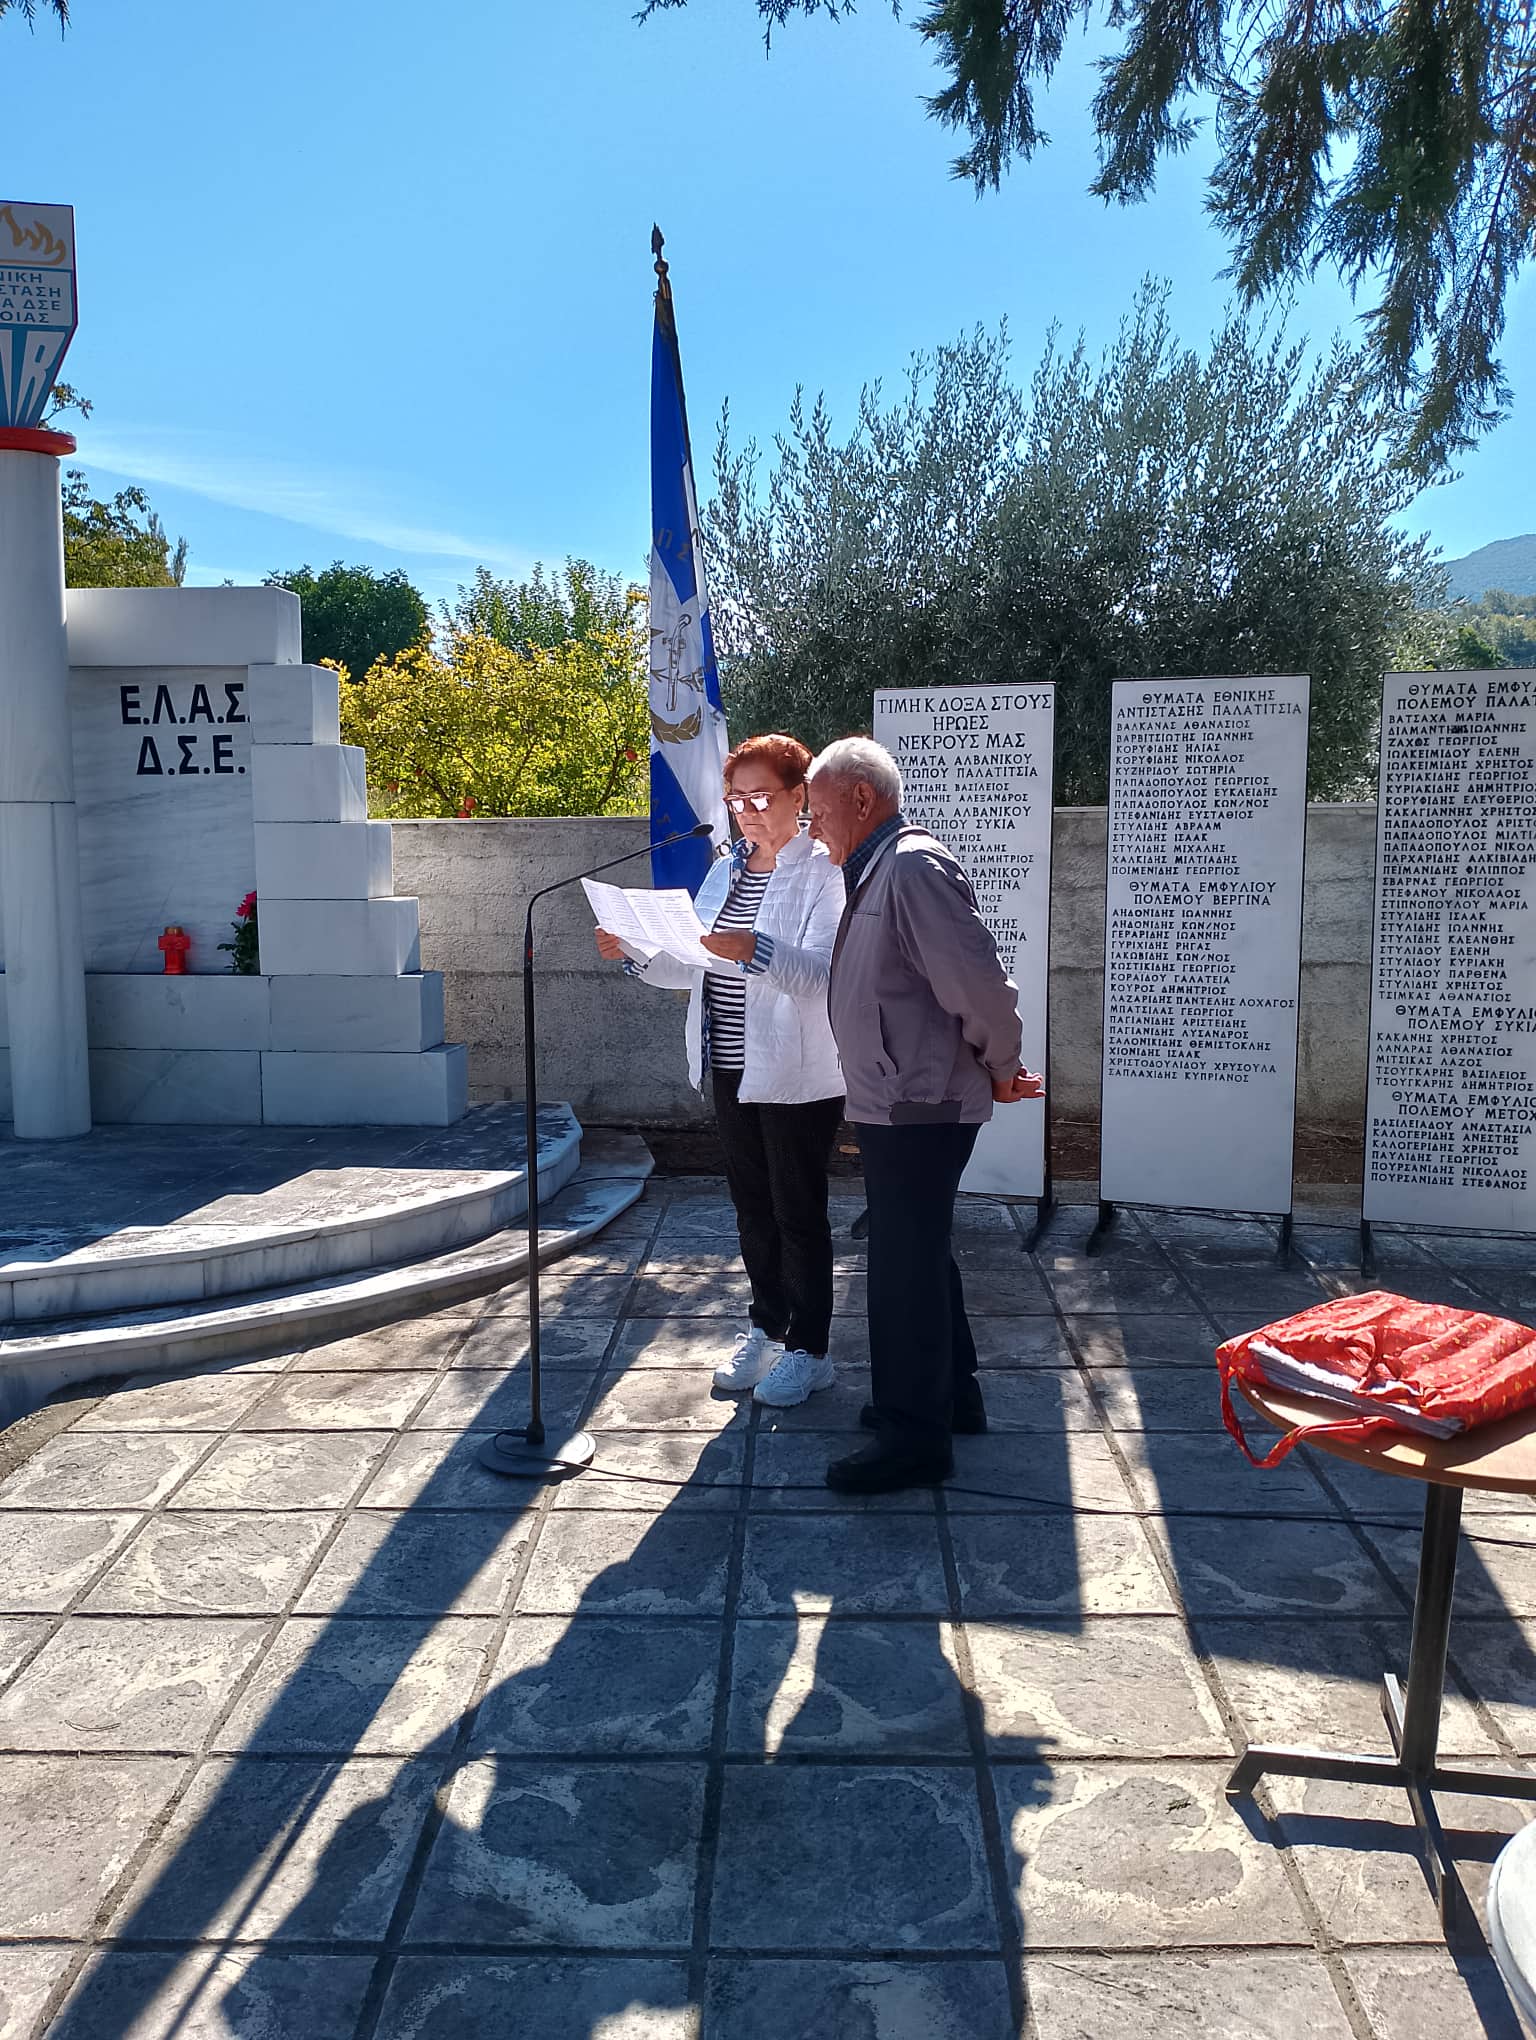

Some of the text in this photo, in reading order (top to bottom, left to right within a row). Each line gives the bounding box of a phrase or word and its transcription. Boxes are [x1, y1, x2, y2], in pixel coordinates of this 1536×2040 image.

[23, 299, 61, 311] ΔΣΕ
[1409, 683, 1478, 696] ΘΥΜΑΤΑ
[1142, 690, 1275, 704] ΘΥΜΑΤΑ ΕΘΝΙΚΗΣ
[876, 698, 921, 714] ΤΙΜΗ
[938, 696, 987, 713] ΔΟΞΑ
[991, 693, 1052, 711] ΣΤΟΥΣ
[1397, 696, 1476, 710] ΠΟΛΕΜΟΥ
[1117, 703, 1302, 719] ΑΝΤΙΣΤΑΣΗΣ ΠΑΛΑΤΙΤΣΙΑ
[932, 714, 989, 731] ΗΡΩΕΣ
[1389, 712, 1495, 724] ΒΑΤΣΑΧΑ ΜΑΡΙΑ
[1183, 720, 1250, 730] ΑΘΑΝΑΣΙΟΣ
[1470, 723, 1527, 734] ΙΩΑΝΝΗΣ
[897, 733, 1026, 751] ΝΕΚΡΟΥΣ ΜΑΣ
[1202, 732, 1254, 742] ΙΩΑΝΝΗΣ
[1438, 735, 1498, 746] ΓΕΩΡΓΙΟΣ
[1116, 743, 1220, 754] ΚΟΡΥΦΙΔΗΣ ΗΛΙΑΣ
[1387, 747, 1520, 759] ΙΩΑΚΕΙΜΙΔΟΥ ΕΛΕΝΗ
[136, 734, 246, 776] Δ.Σ.Ε.
[954, 753, 1032, 766] ΑΛΒΑΝΙΚΟΥ
[1116, 754, 1245, 765] ΚΟΡΥΦΙΔΗΣ ΝΙΚΟΛΑΟΣ
[1115, 765, 1236, 776] ΚΥΖΗΡΙΔΟΥ ΣΩΤΗΡΙΑ
[1387, 759, 1534, 771] ΙΩΑΚΕΙΜΙΔΗΣ ΧΡΗΣΤΟΣ
[957, 765, 1038, 779] ΠΑΛΑΤΙΤΣΙΑ
[1386, 771, 1529, 783] ΚΥΡΙΑΚΙΔΗΣ ΓΕΩΡΓΙΟΣ
[954, 782, 1010, 792] ΒΑΣΙΛΕΙΟΣ
[1115, 776, 1269, 787] ΠΑΠΑΔΟΠΟΥΛΟΣ ΓΕΩΡΓΙΟΣ
[1115, 787, 1278, 798] ΠΑΠΑΔΟΠΟΥΛΟΣ ΕΥΚΛΕΙΔΗΣ
[1386, 783, 1460, 794] ΚΥΡΙΑΚΙΔΗΣ
[958, 793, 1028, 803] ΑΛΕΞΑΝΔΡΟΣ
[1385, 795, 1455, 806] ΚΟΡΥΦΙΔΗΣ
[1114, 799, 1207, 809] ΠΑΠΑΔΟΠΟΥΛΟΣ
[953, 806, 1031, 818] ΑΛΒΑΝΙΚΟΥ
[1114, 810, 1254, 821] ΣΤΕΦΑΝΙΔΗΣ ΕΥΣΤΑΘΙΟΣ
[1385, 807, 1473, 817] ΚΑΚΑΓΙΑΝΝΗΣ
[976, 818, 1016, 830] ΣΥΚΙΑ
[1113, 821, 1221, 831] ΣΤΥΛΙΔΗΣ ΑΒΡΑΑΜ
[1384, 818, 1488, 829] ΠΑΠΑΔΟΠΟΥΛΟΣ
[1113, 832, 1208, 842] ΣΤΥΛΙΔΗΣ ΙΣΑΑΚ
[1384, 830, 1487, 841] ΠΑΠΑΔΟΠΟΥΛΟΣ
[958, 844, 1007, 853] ΜΙΧΑΛΗΣ
[1112, 844, 1226, 854] ΣΤΥΛΙΔΗΣ ΜΙΧΑΛΗΣ
[1384, 842, 1487, 852] ΠΑΠΑΔΟΠΟΥΛΟΣ
[973, 854, 1034, 865] ΔΗΜΗΤΡΙΟΣ
[1112, 855, 1237, 865] ΧΑΛΚΙΔΗΣ ΜΙΛΤΙΑΔΗΣ
[1383, 854, 1460, 864] ΠΑΡΧΑΡΙΔΗΣ
[1112, 866, 1240, 876] ΠΟΙΜΕΝΙΔΗΣ ΓΕΩΡΓΙΟΣ
[1465, 865, 1526, 875] ΦΙΛΙΠΠΟΣ
[972, 880, 1021, 891] ΕΡΓΙΝΑ
[1129, 881, 1276, 893] ΘΥΜΑΤΑ ΕΜΦΥΛΙΟΥ
[1382, 877, 1504, 887] ΣΒΑΡΝΑΣ ΓΕΩΡΓΙΟΣ
[1382, 888, 1521, 899] ΣΤΕΦΑΝΟΥ ΝΙΚΟΛΑΟΣ
[1134, 894, 1271, 906] ΠΟΛΕΜΟΥ ΒΕΡΓΙΝΑ
[1489, 900, 1528, 910] ΜΑΡΙΑ
[1112, 908, 1232, 919] ΑΗΔΟΝΙΔΗΣ ΙΩΑΝΝΗΣ
[1381, 911, 1486, 921] ΣΤΥΛΙΔΗΣ ΙΣΑΑΚ
[1112, 919, 1175, 930] ΑΗΔΟΝΙΔΗΣ
[1380, 923, 1504, 933] ΣΤΥΛΙΔΗΣ ΙΩΑΝΝΗΣ
[1112, 930, 1227, 940] ΓΕΡΑΡΙΔΗΣ ΙΩΑΝΝΗΣ
[1380, 934, 1515, 945] ΣΤΥΛΙΔΗΣ ΚΛΕΑΝΘΗΣ
[1175, 942, 1211, 951] ΡΗΓΑΣ
[1380, 945, 1490, 956] ΣΤΥΛΙΔΟΥ ΕΛΕΝΗ
[1110, 961, 1236, 973] ΚΩΣΤΙΚΙΔΗΣ ΓΕΩΡΓΙΟΣ
[1379, 957, 1504, 968] ΣΤΥΛΙΔΟΥ ΚΥΡΙΑΚΗ
[1174, 974, 1230, 985] ΓΑΛΑΤΕΙΑ
[1379, 968, 1507, 980] ΣΤΥΛΙΔΟΥ ΠΑΡΘΕΝΑ
[1110, 983, 1226, 995] ΚΟΥΡΟΣ ΔΗΜΗΤΡΙΟΣ
[1378, 979, 1503, 991] ΣΤΥΛΙΔΗΣ ΧΡΗΣΤΟΣ
[1110, 994, 1295, 1008] ΛΑΖΑΡΙΔΗΣ ΠΑΝΤΕΛΗΣ ΛΟΧΑΓΟΣ
[1439, 992, 1511, 1002] ΑΘΑΝΑΣΙΟΣ
[1180, 1007, 1234, 1017] ΓΕΩΡΓΙΟΣ
[1395, 1005, 1462, 1018] ΘΥΜΑΤΑ
[1109, 1015, 1246, 1029] ΠΑΓΙΑΝΙΔΗΣ ΑΡΙΣΤΕΙΔΗΣ
[1408, 1018, 1485, 1031] ΠΟΛΕΜΟΥ
[1109, 1026, 1249, 1039] ΠΑΓΙΑΝΙΔΗΣ ΛΥΣΑΝΔΡΟΣ
[1109, 1036, 1271, 1051] ΣΑΛΟΝΙΚΙΔΗΣ ΘΕΜΙΣΤΟΚΛΗΣ
[1377, 1032, 1497, 1045] ΚΑΚΑΝΗΣ ΧΡΗΣΤΟΣ
[1109, 1046, 1201, 1059] ΧΙΟΝΙΔΗΣ ΙΣΑΑΚ
[1440, 1046, 1513, 1057] ΑΘΑΝΑΣΙΟΣ
[1108, 1057, 1276, 1073] ΧΡΙΣΤΟΔΟΥΛΙΔΟΥ ΧΡΥΣΟΥΛΑ
[1376, 1055, 1482, 1067] ΜΙΤΣΙΚΑΣ ΛΑΖΟΣ
[1185, 1072, 1249, 1083] ΚΥΠΡΙΑΝΟΣ
[1376, 1066, 1527, 1080] ΤΣΟΥΓΚΑΡΗΣ ΒΑΣΙΛΕΙΟΣ
[1376, 1077, 1534, 1092] ΤΣΟΥΓΚΑΡΗΣ ΔΗΜΗΤΡΙΟΣ
[1392, 1091, 1458, 1105] ΘΥΜΑΤΑ
[1398, 1104, 1475, 1118] ΠΟΛΕΜΟΥ
[1373, 1118, 1532, 1135] ΒΑΣΙΛΕΙΑΔΟΥ ΑΝΑΣΤΑΣΙΑ
[1373, 1128, 1519, 1144] ΚΑΛΟΓΕΡΙΔΗΣ ΑΝΕΣΤΗΣ
[1372, 1139, 1519, 1156] ΚΑΛΟΓΕΡΙΔΗΣ ΧΡΗΣΤΟΣ
[1372, 1150, 1498, 1166] ΠΑΥΛΙΔΗΣ ΓΕΩΡΓΙΟΣ
[1371, 1161, 1527, 1179] ΠΟΥΡΣΑΝΙΔΗΣ ΝΙΚΟΛΑΟΣ
[1371, 1172, 1527, 1190] ΠΟΥΡΣΑΝΙΔΗΣ ΣΤΕΦΑΝΟΣ
